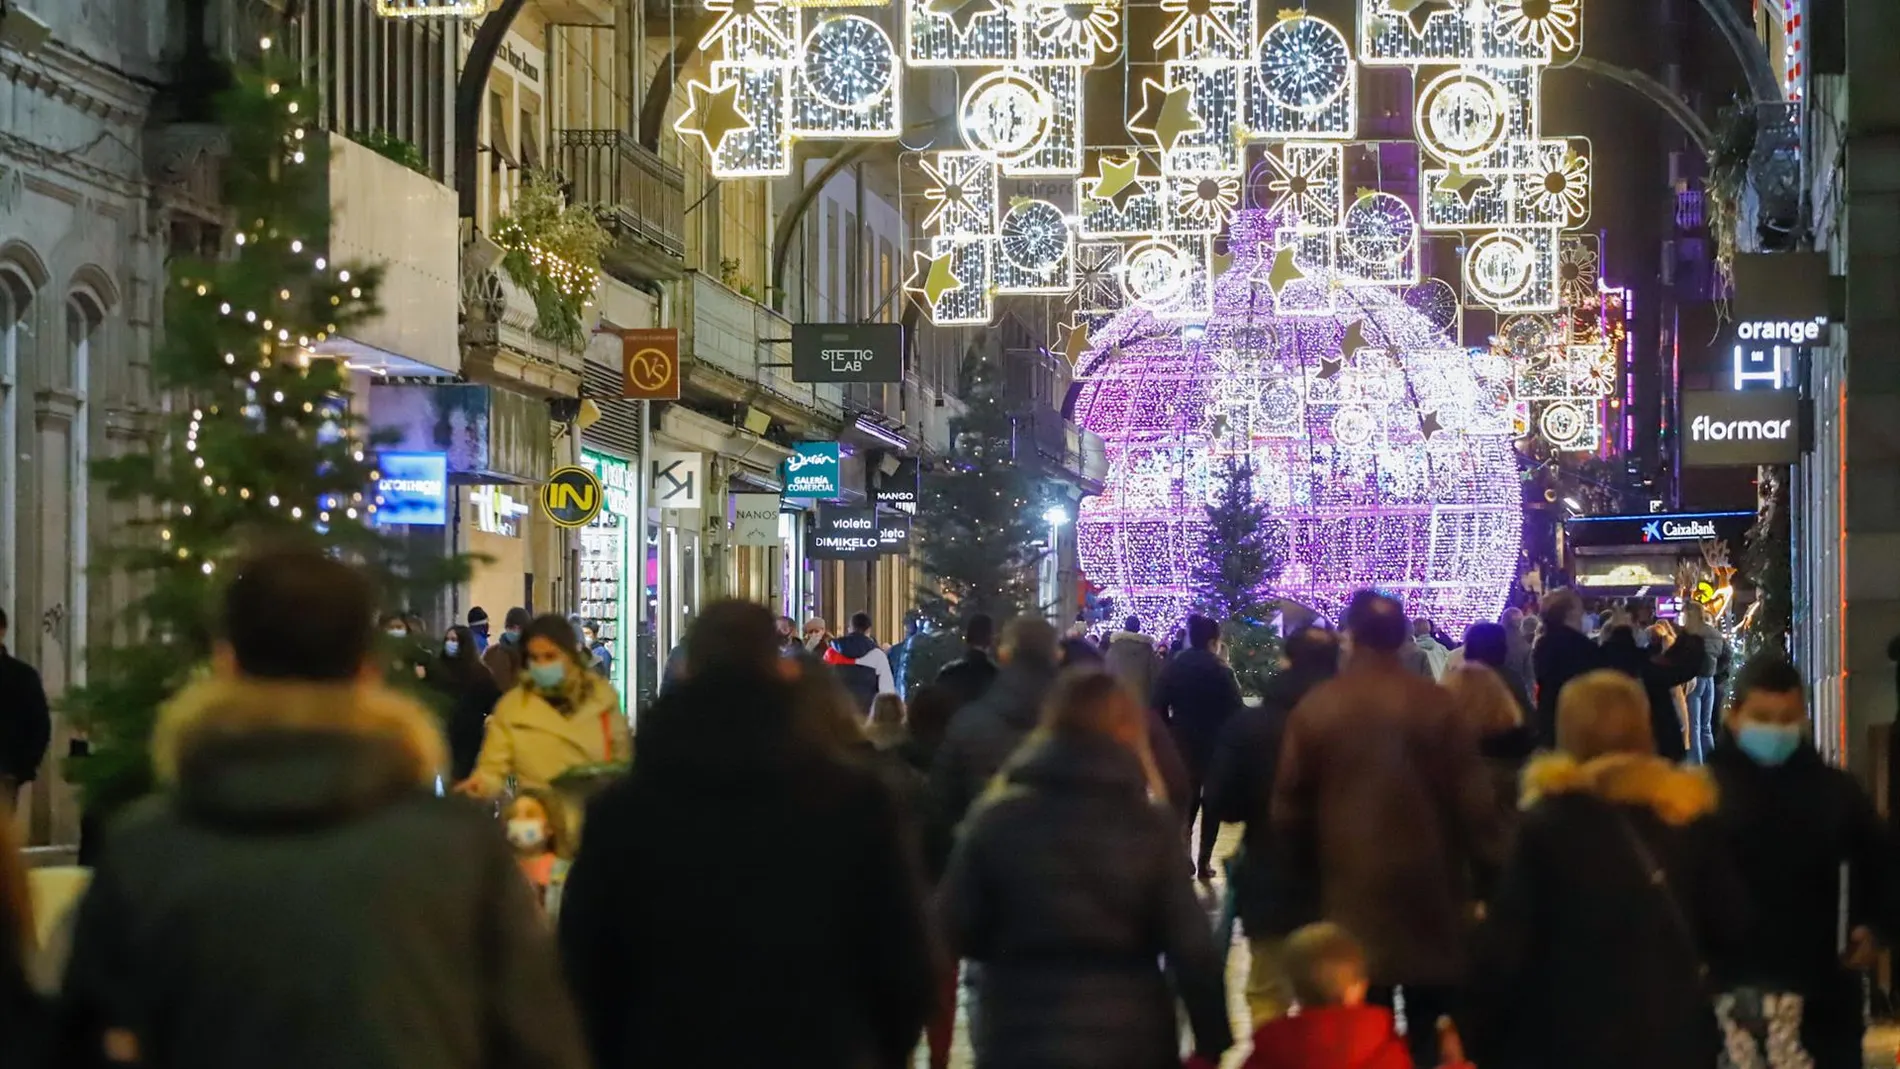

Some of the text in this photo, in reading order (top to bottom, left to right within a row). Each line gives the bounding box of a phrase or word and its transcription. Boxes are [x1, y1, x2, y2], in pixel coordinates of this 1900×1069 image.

[821, 349, 874, 361] STETIC
[831, 360, 862, 372] LAB
[1691, 415, 1791, 441] flormar
[793, 475, 829, 484] GALERÍA
[787, 484, 834, 492] COMERCIAL
[550, 483, 593, 511] IN
[877, 492, 914, 500] MANGO
[736, 510, 778, 520] NANOS
[833, 518, 872, 529] violeta
[1662, 520, 1716, 536] CaixaBank
[879, 527, 905, 539] oleta
[815, 537, 878, 548] DIMIKELO
